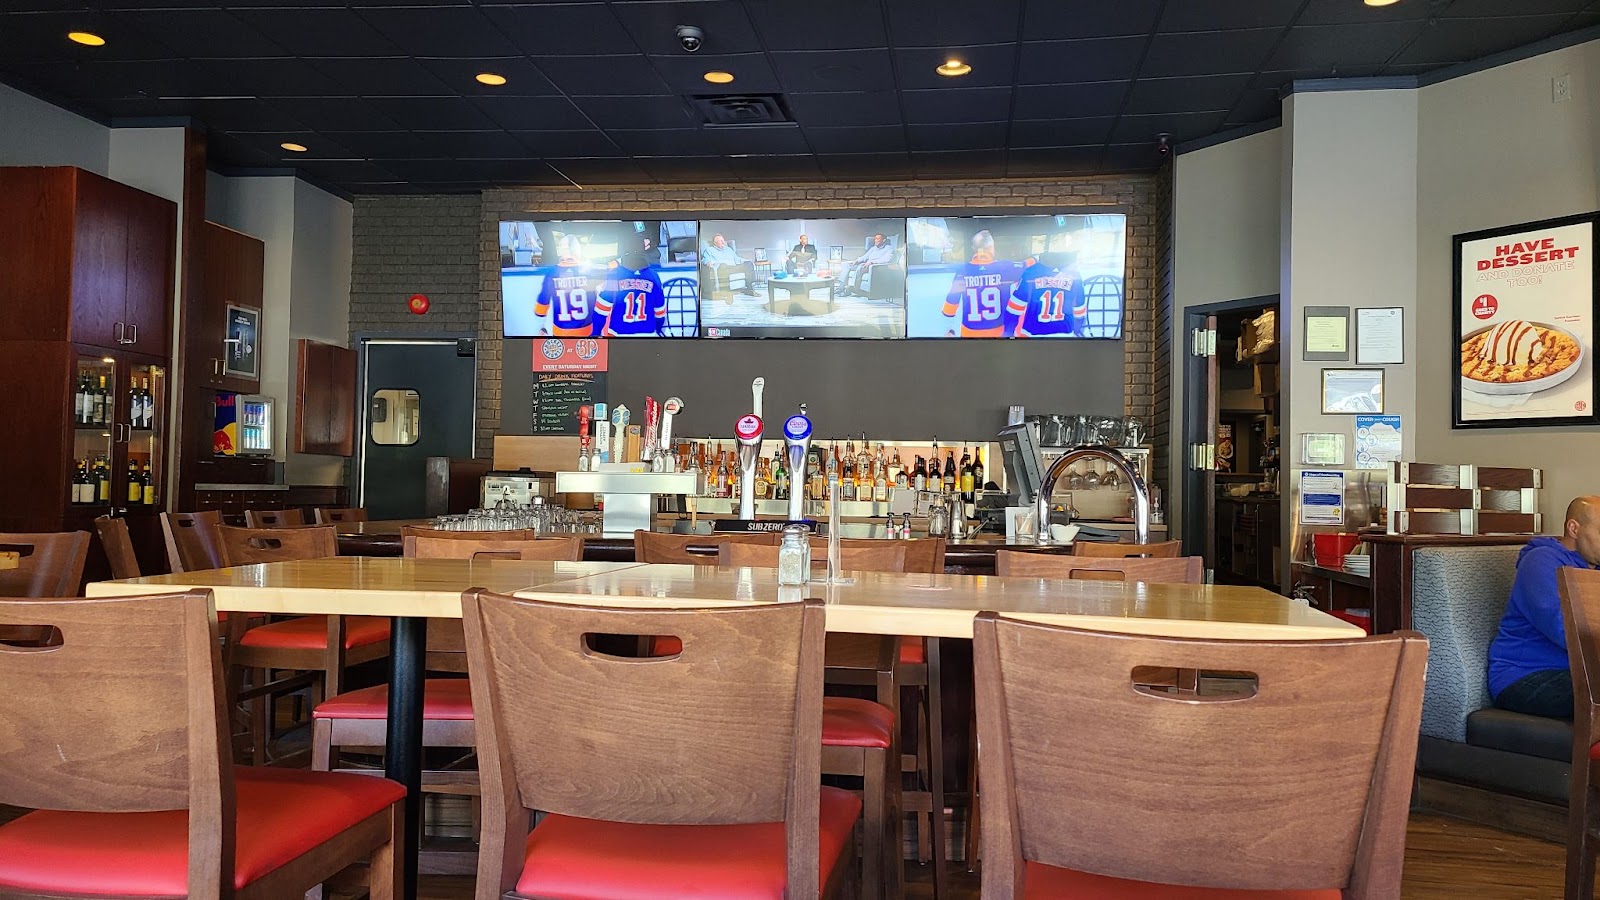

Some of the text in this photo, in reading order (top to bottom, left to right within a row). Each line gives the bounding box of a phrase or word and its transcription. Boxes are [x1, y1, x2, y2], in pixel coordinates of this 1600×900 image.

[1496, 238, 1554, 256] HAVE
[1477, 247, 1579, 271] DESSERT
[552, 276, 588, 288] TROTTIER
[964, 274, 1002, 287] TROTTIER
[1477, 260, 1576, 282] AND DONATE
[556, 289, 588, 321] 19
[623, 292, 647, 322] 11
[966, 288, 1001, 321] 19
[1037, 290, 1065, 322] 11
[747, 522, 784, 531] SUBZERO
